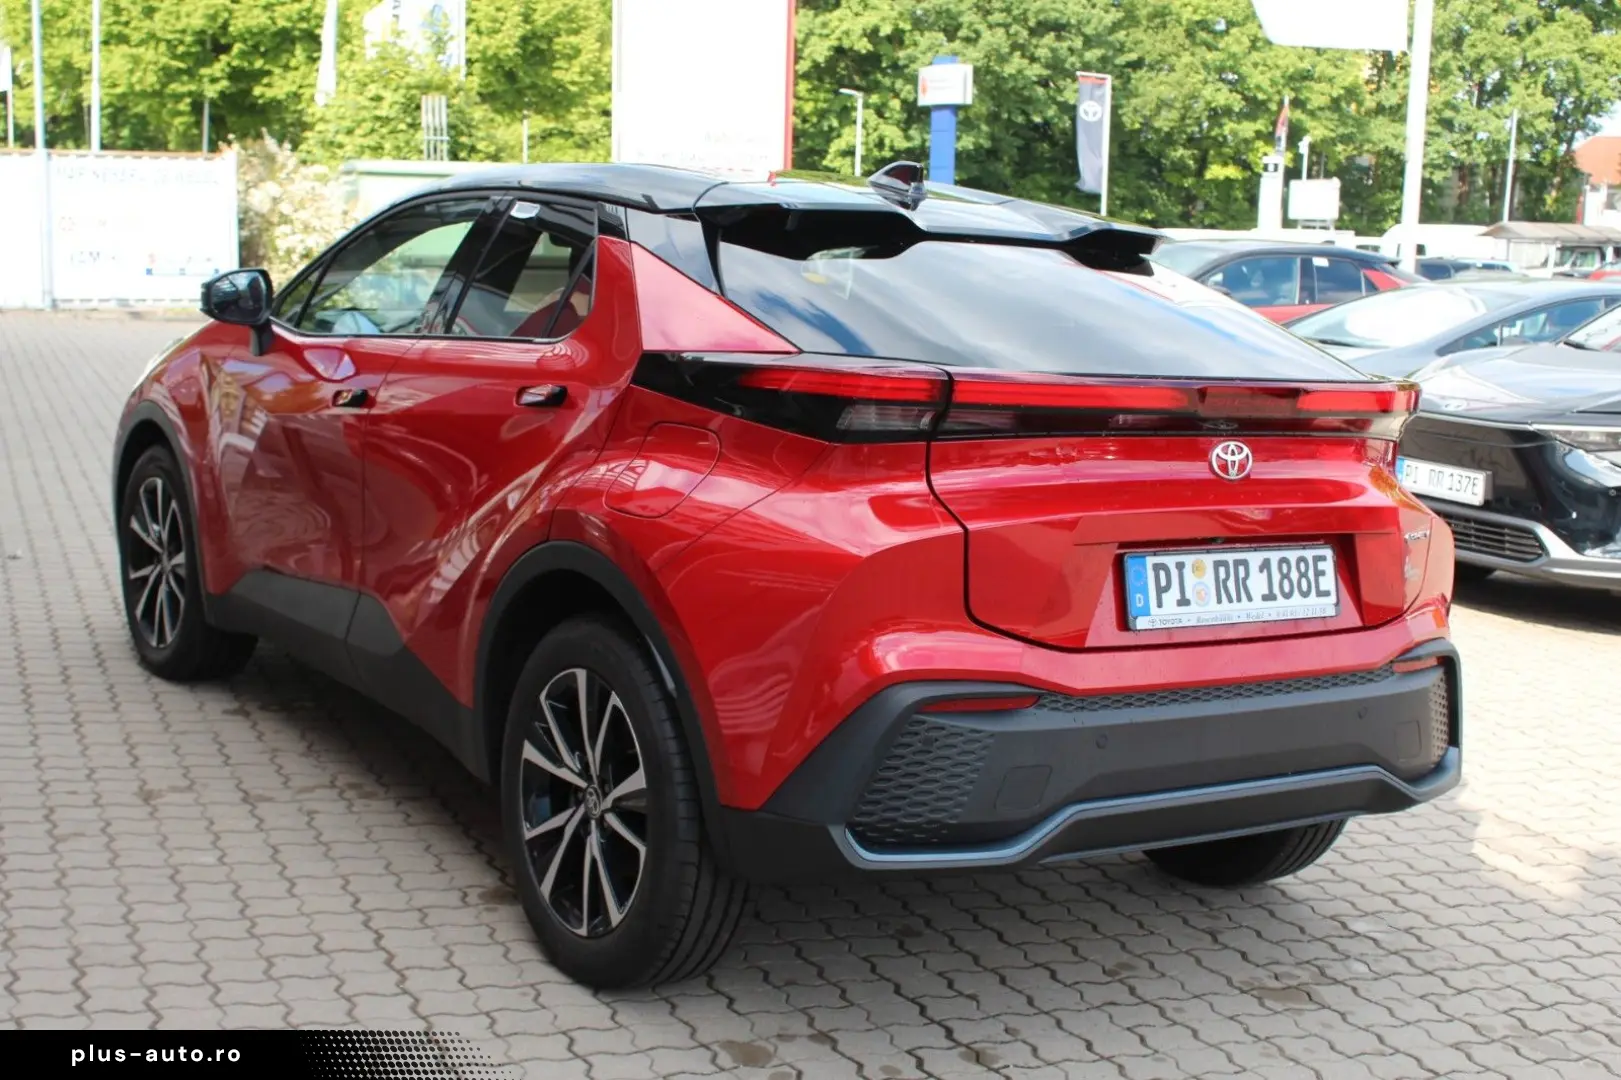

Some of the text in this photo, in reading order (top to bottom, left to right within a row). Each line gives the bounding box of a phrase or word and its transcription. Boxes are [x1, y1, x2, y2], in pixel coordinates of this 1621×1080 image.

[1428, 469, 1445, 488] RR
[1447, 472, 1479, 496] 137E
[1152, 555, 1331, 608] PI RR 188E
